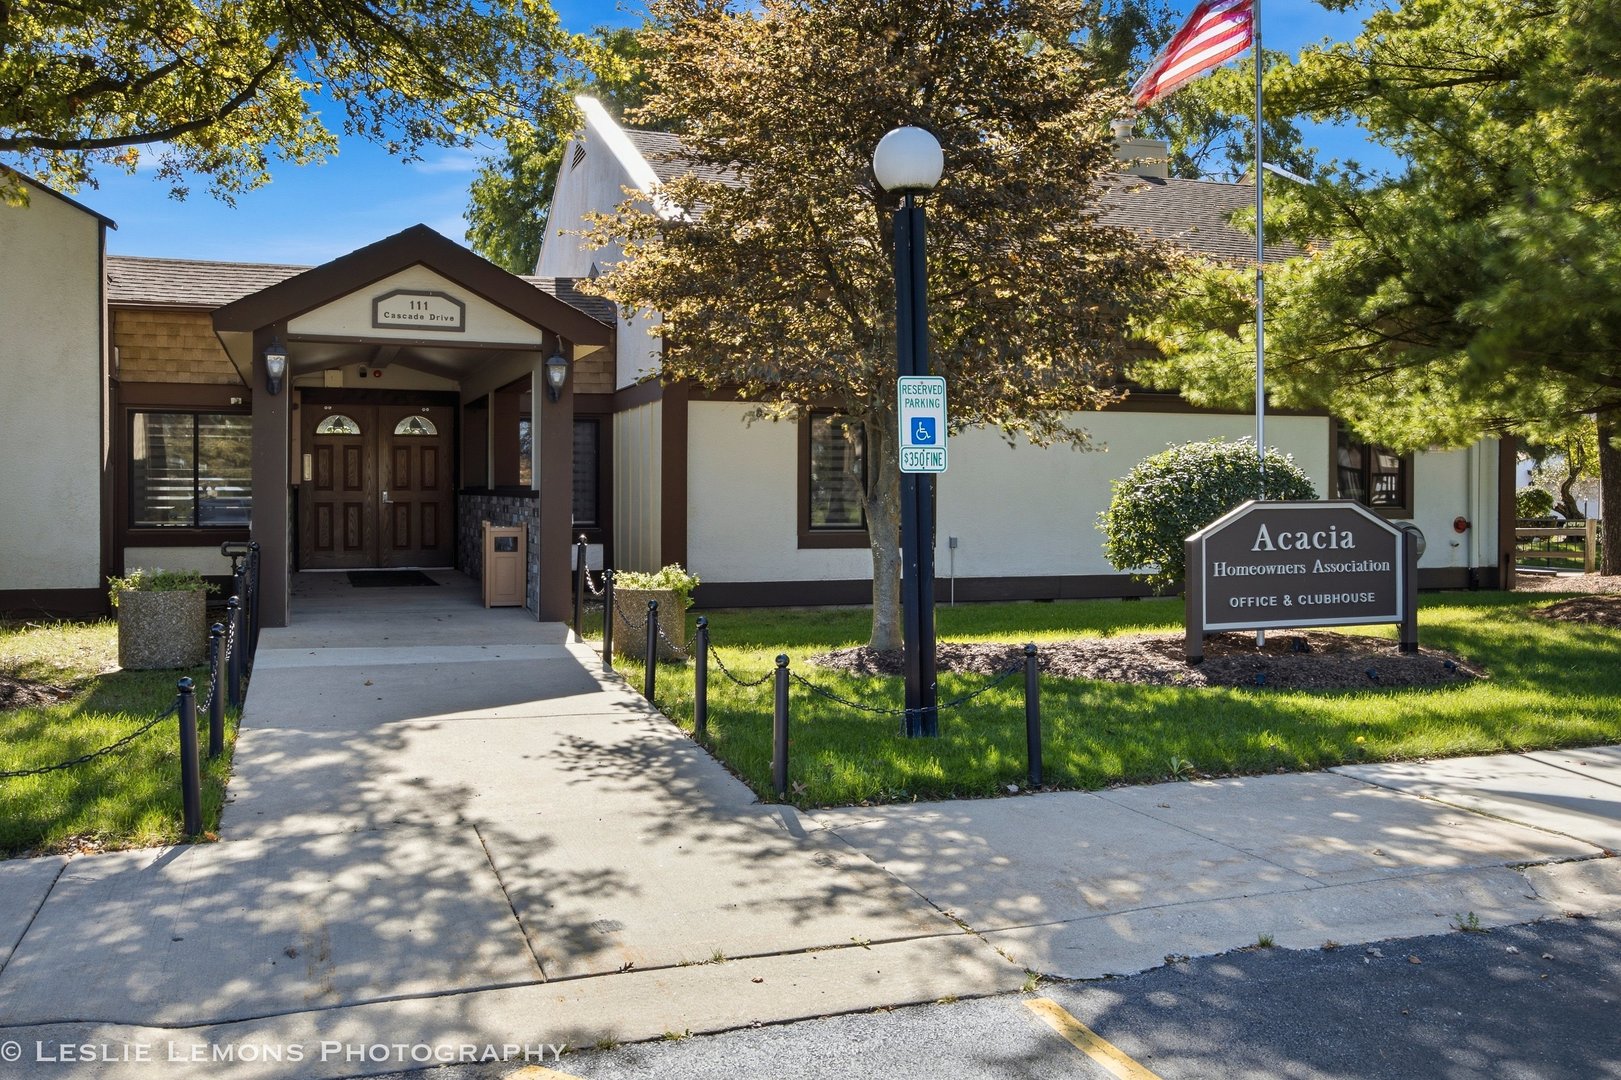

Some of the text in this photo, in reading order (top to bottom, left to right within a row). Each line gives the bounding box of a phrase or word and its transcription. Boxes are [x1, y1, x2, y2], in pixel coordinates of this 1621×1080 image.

[409, 300, 428, 311] 111
[383, 311, 455, 322] Cascade Drive
[902, 384, 943, 395] RESERVED
[904, 398, 940, 409] PARKING
[903, 451, 943, 467] $350 FINE
[1250, 523, 1356, 552] Acacia
[1213, 559, 1391, 577] Homeowners Association
[1229, 592, 1376, 608] OFFICE & CLUBHOUSE
